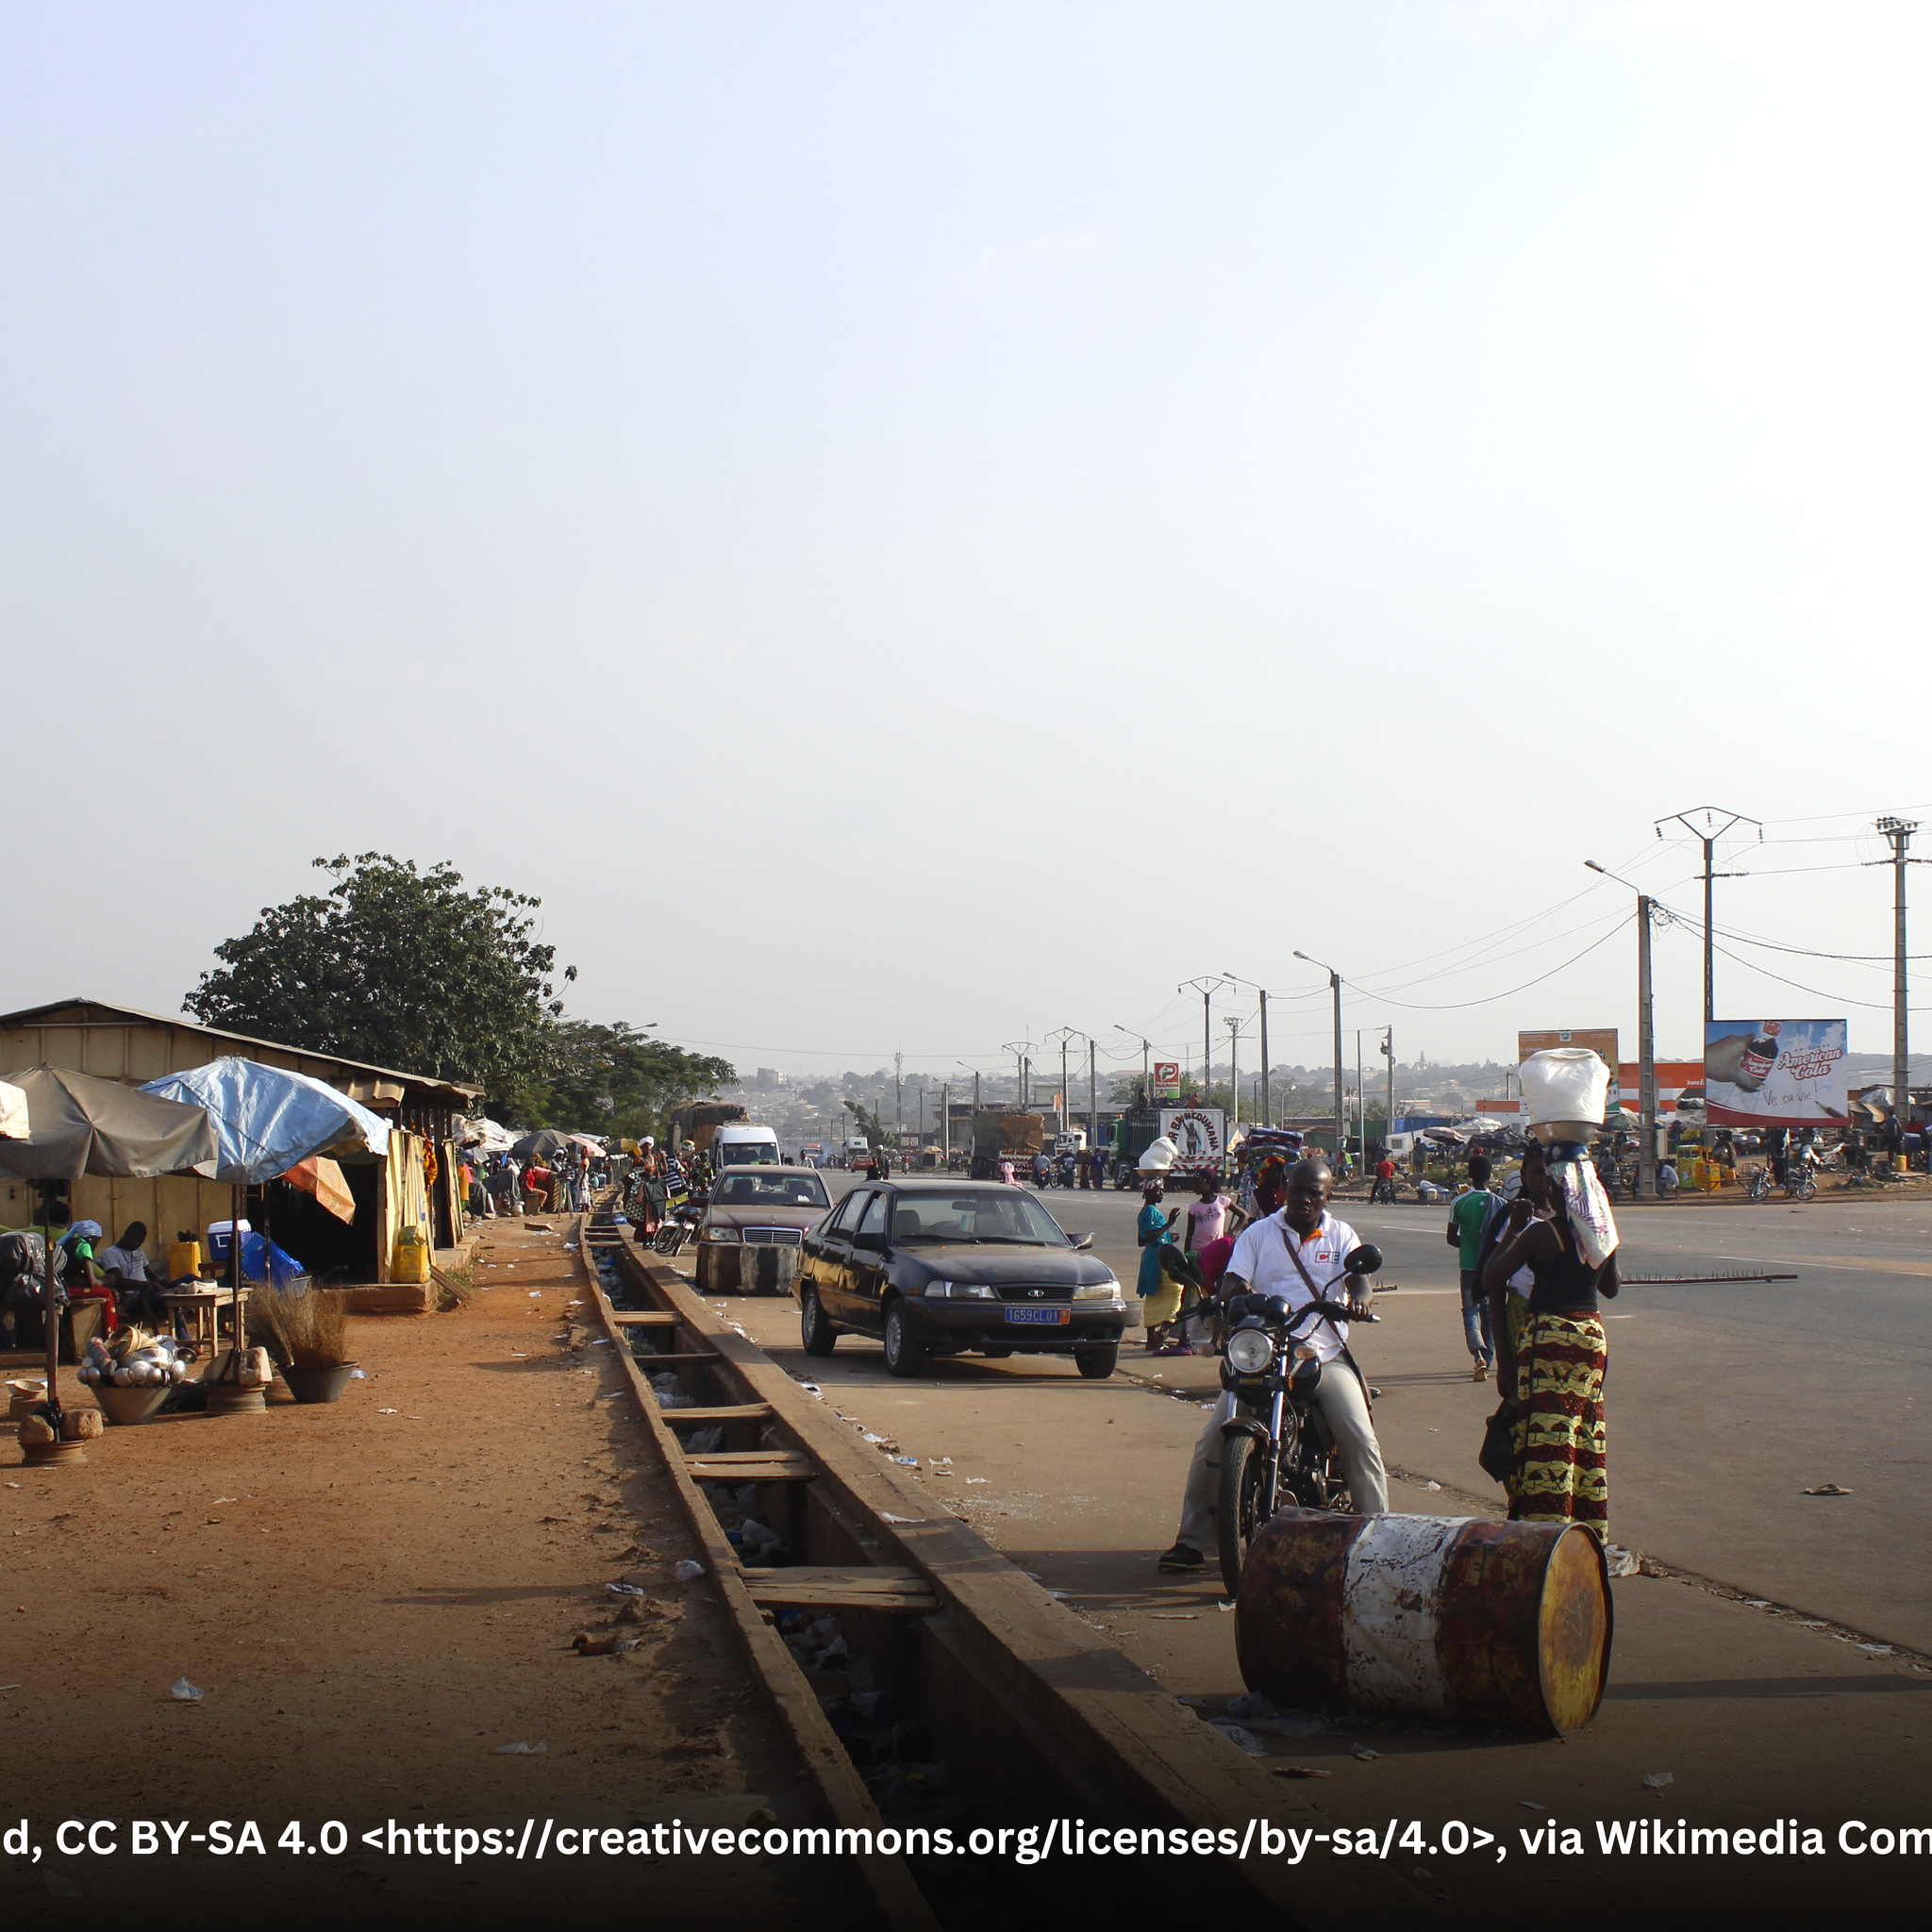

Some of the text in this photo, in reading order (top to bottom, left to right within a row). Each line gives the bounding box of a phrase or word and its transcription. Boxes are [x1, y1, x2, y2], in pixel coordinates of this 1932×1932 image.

[1777, 1048, 1843, 1071] American
[1790, 1063, 1831, 1081] Cola
[1763, 1090, 1777, 1107] Vis
[1781, 1093, 1794, 1104] ta
